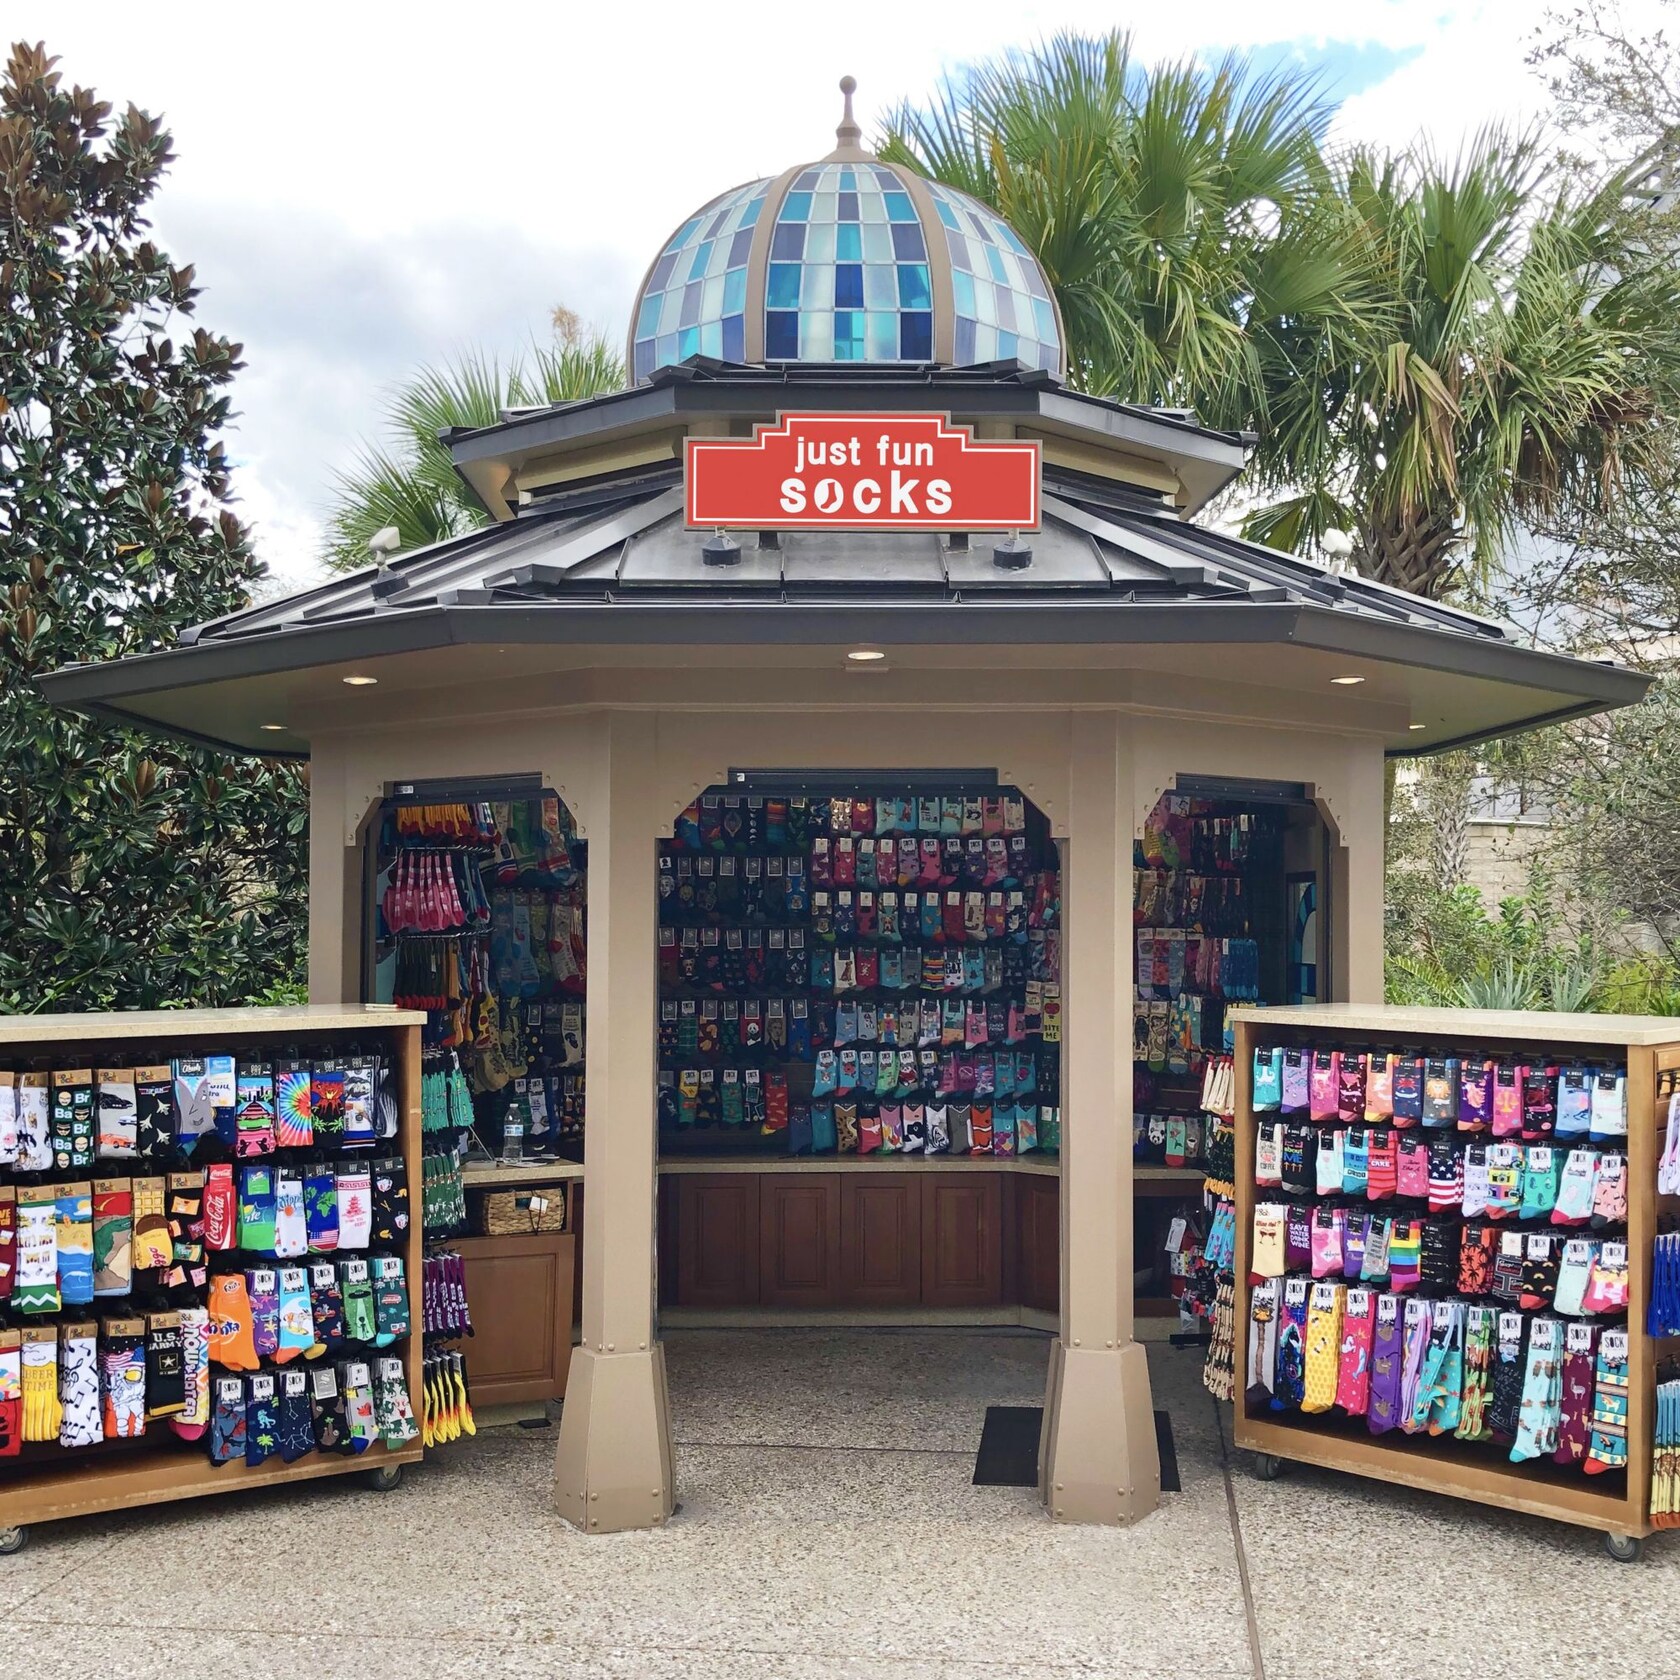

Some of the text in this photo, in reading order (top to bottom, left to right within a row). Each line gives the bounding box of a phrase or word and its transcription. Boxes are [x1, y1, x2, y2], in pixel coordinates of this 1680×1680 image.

[794, 435, 933, 472] just fun
[779, 470, 952, 514] socks
[75, 1093, 90, 1103] Br
[55, 1108, 72, 1118] Ba
[74, 1124, 89, 1134] Br
[55, 1139, 72, 1150] Ba
[73, 1154, 88, 1165] Br
[1284, 1152, 1303, 1163] ME
[1604, 1159, 1617, 1168] SOCK
[205, 1194, 225, 1245] Coca-Cola
[1289, 1223, 1309, 1231] SAVE
[1290, 1229, 1309, 1237] WATER
[1290, 1235, 1310, 1243] DRINK
[1531, 1239, 1547, 1248] SOCK
[1290, 1241, 1310, 1249] WINE
[1569, 1243, 1585, 1253] SOCK
[1605, 1247, 1622, 1257] SOCK
[350, 1264, 364, 1275] SOCK
[384, 1260, 398, 1271] SOCK
[257, 1274, 272, 1283] SOCK
[284, 1271, 300, 1282] SOCK
[316, 1268, 331, 1279] SOCK
[1288, 1283, 1303, 1294] SOCK
[1316, 1288, 1332, 1298] SOCK
[1350, 1293, 1366, 1304] SOCK
[1381, 1300, 1394, 1311] SOCK
[1502, 1319, 1518, 1330] SOCK
[1534, 1324, 1549, 1334] SOCK
[153, 1333, 180, 1342] U.S.
[1571, 1329, 1588, 1340] SOCK
[151, 1340, 182, 1350] ARMY
[1605, 1337, 1625, 1348] SOCK
[25, 1369, 53, 1379] BEER
[25, 1381, 54, 1391] TIME
[255, 1380, 271, 1390] SOCK
[288, 1376, 302, 1386] SOCK
[224, 1382, 239, 1393] SOCK
